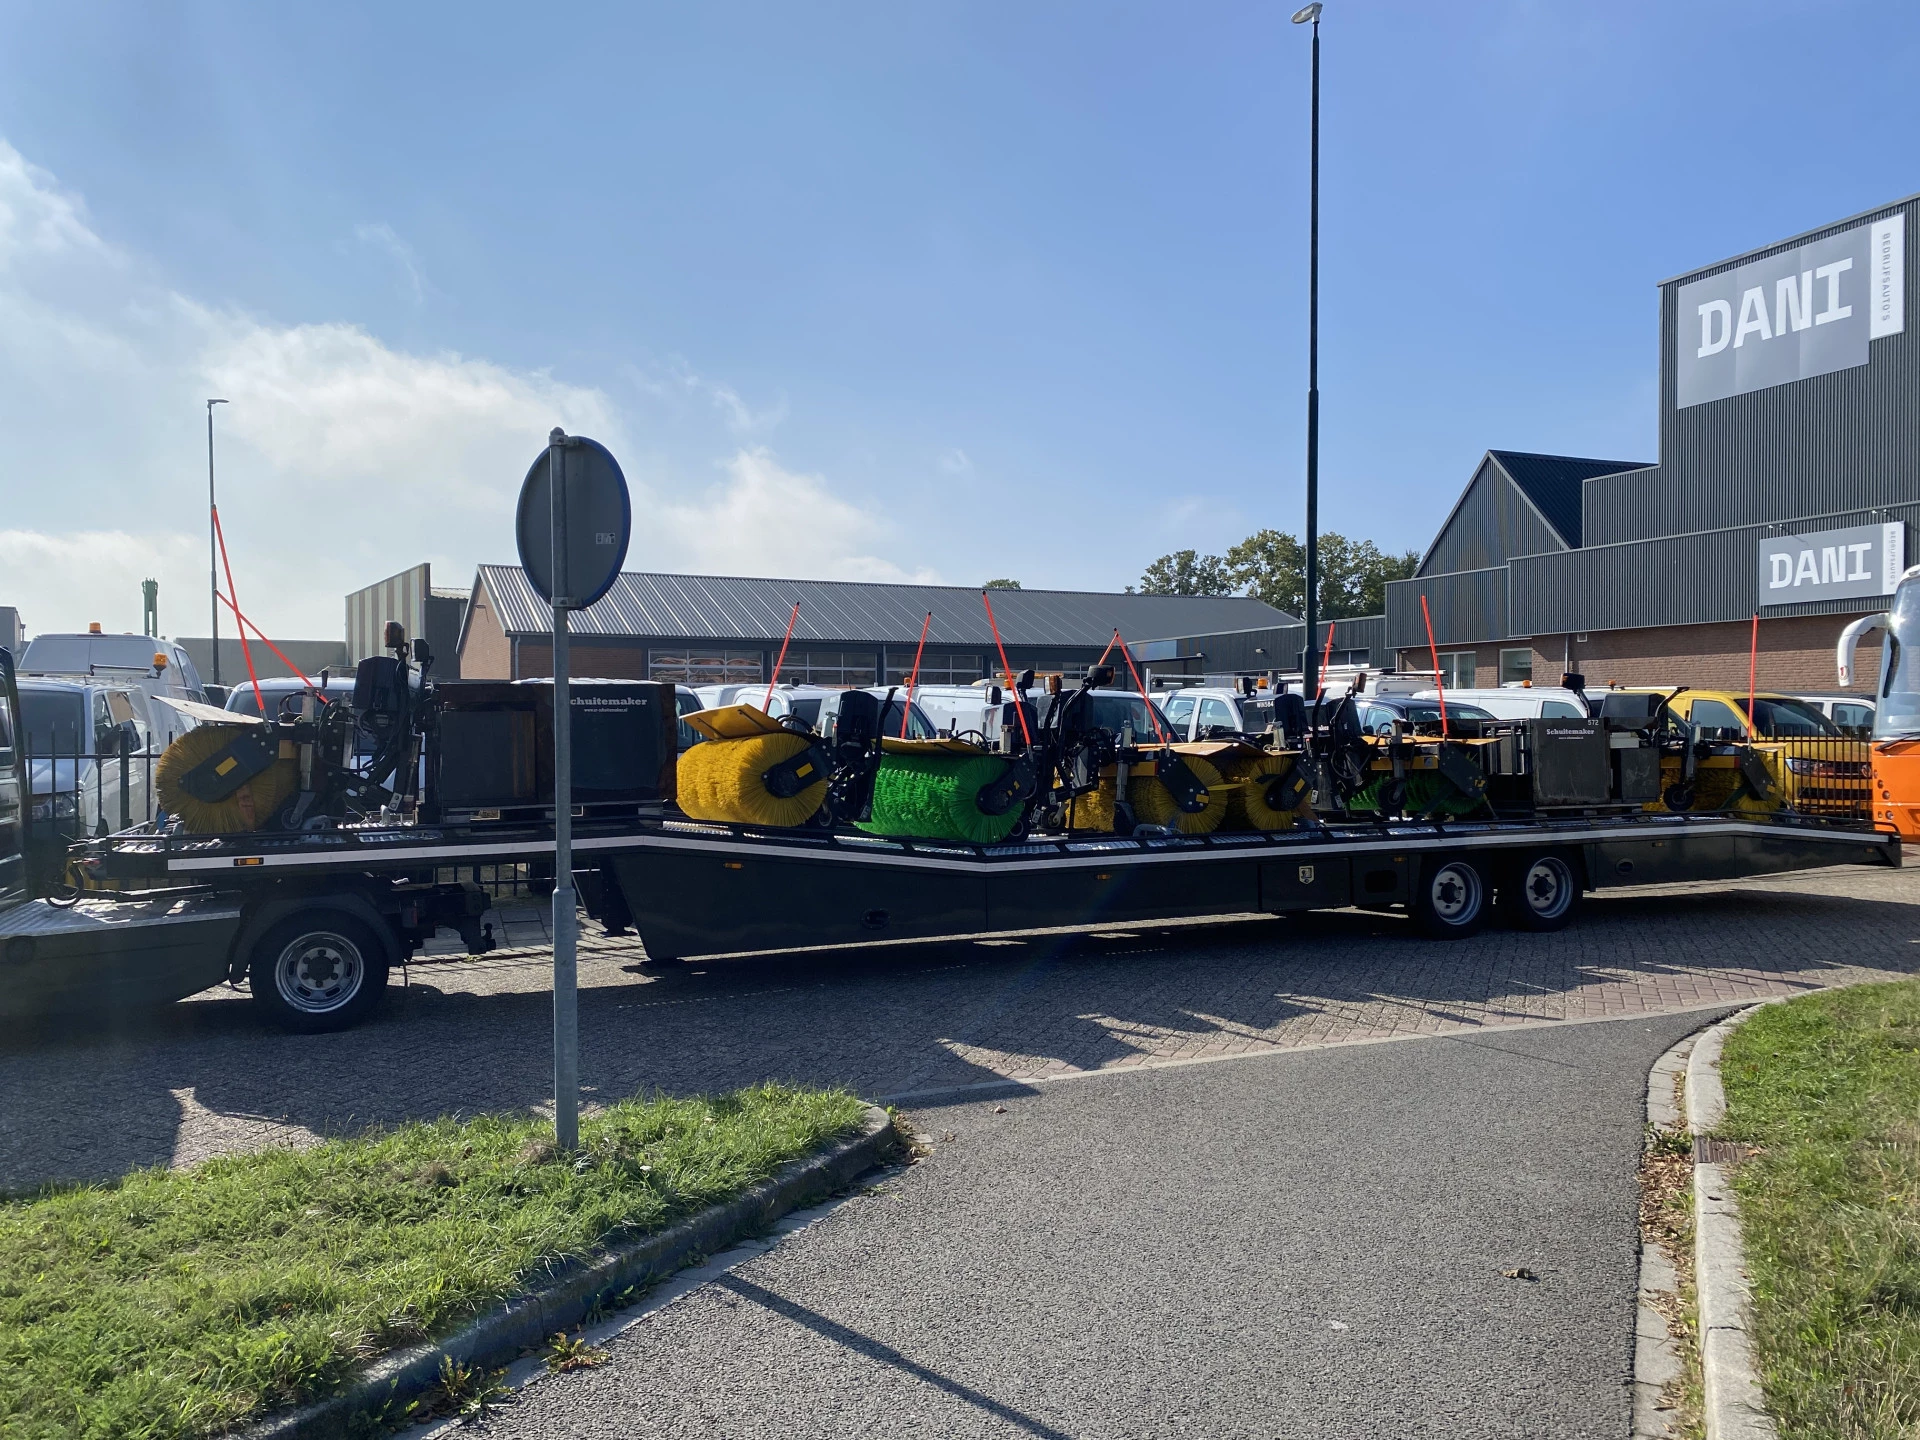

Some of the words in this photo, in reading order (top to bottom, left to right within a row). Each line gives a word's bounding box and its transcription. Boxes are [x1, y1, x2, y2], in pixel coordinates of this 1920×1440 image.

[1698, 257, 1853, 358] DANI
[1882, 232, 1891, 321] BEDRIJFSAUTO'S
[1769, 542, 1872, 589] DANI
[570, 697, 647, 705] chuitemaker
